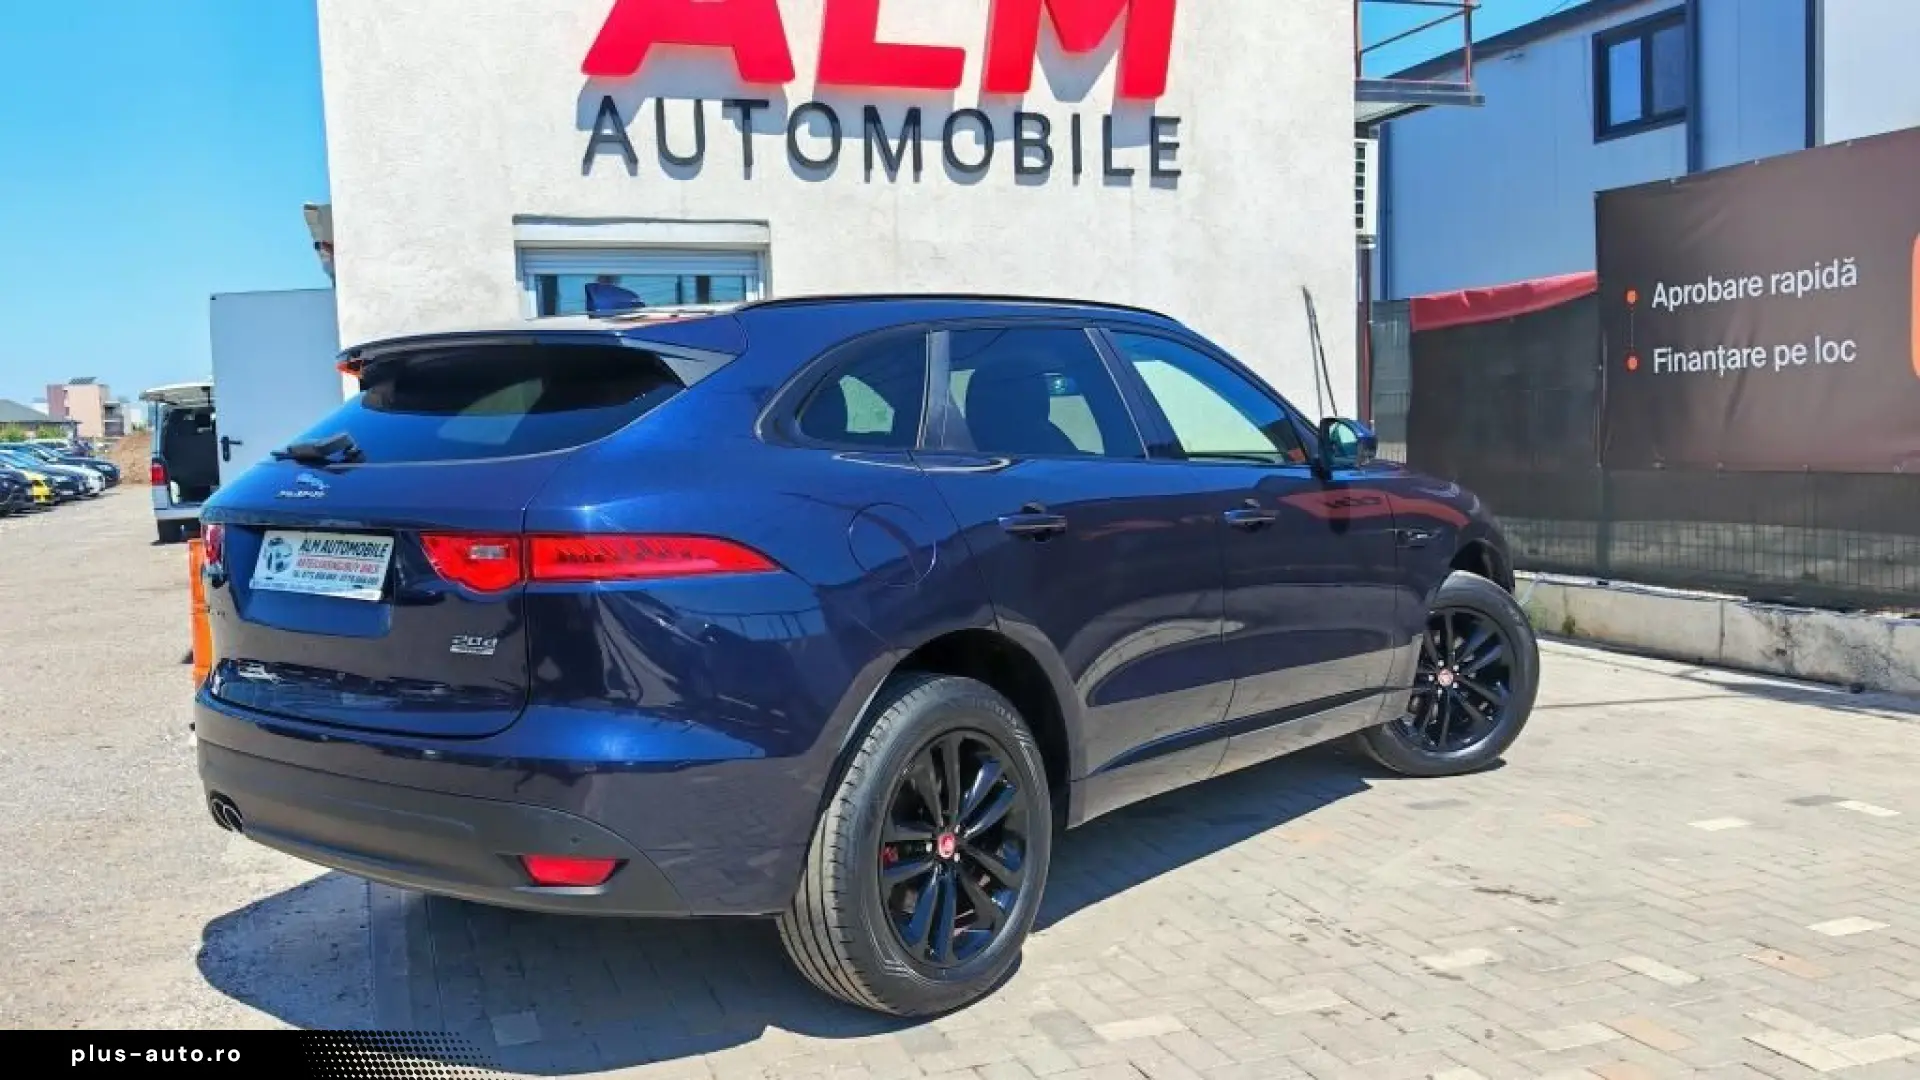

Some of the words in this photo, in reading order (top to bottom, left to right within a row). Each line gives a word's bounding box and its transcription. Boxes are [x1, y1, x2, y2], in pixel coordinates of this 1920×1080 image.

[581, 0, 1177, 98] ALM
[582, 95, 1182, 179] AUTOMOBILE
[1651, 274, 1765, 312] Aprobare
[1771, 256, 1858, 299] rapidă
[1653, 344, 1767, 376] Finanțare
[1774, 342, 1807, 372] pe
[1814, 335, 1858, 364] loc
[321, 539, 390, 558] AUTOMOBILE
